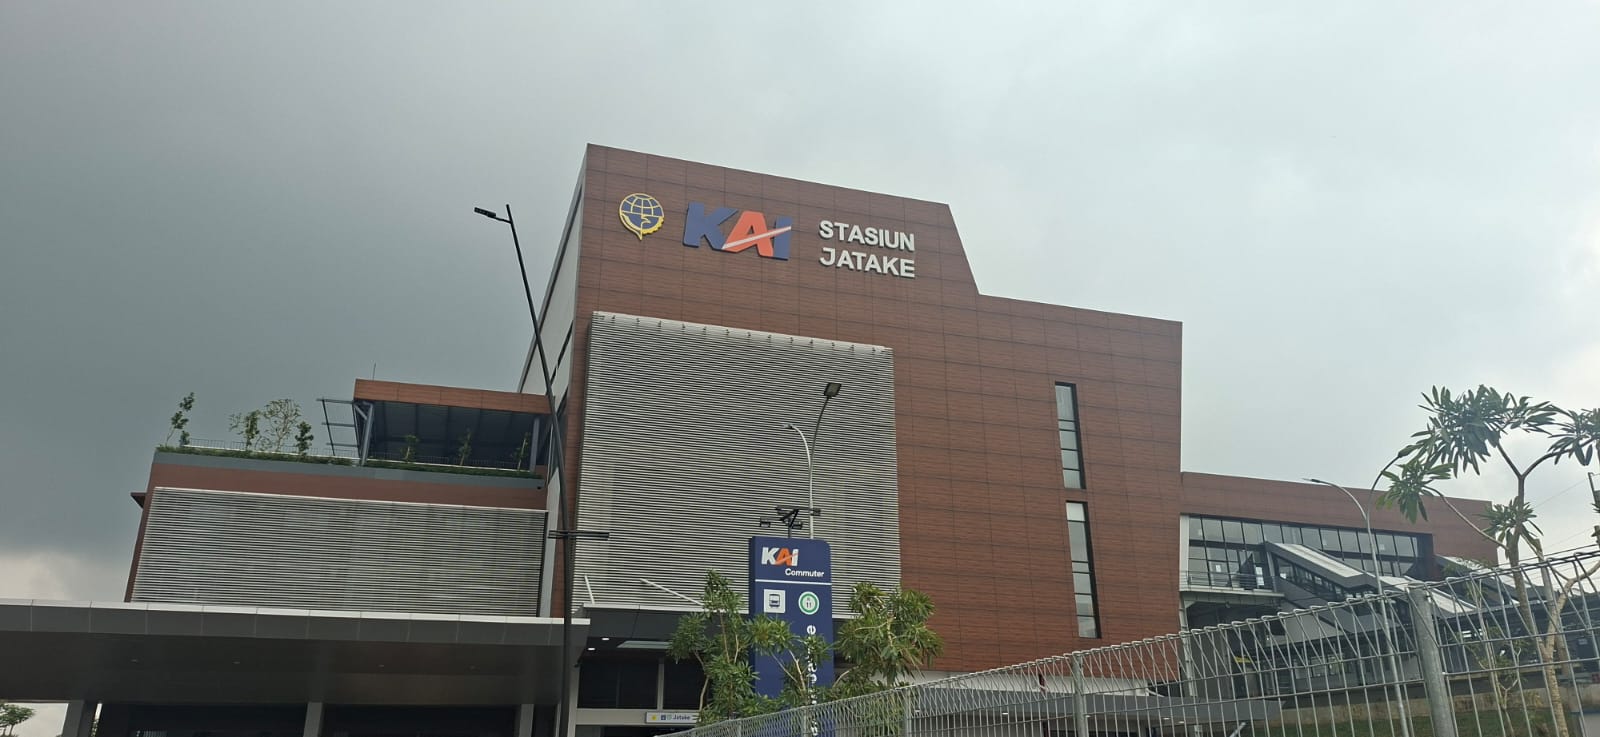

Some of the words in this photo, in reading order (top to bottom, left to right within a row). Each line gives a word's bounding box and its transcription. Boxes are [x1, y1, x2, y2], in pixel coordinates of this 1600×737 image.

[682, 202, 792, 260] KAI
[819, 220, 915, 252] STASIUN
[819, 247, 915, 278] JATAKE
[761, 547, 799, 567] KAI
[785, 568, 825, 577] Commuter
